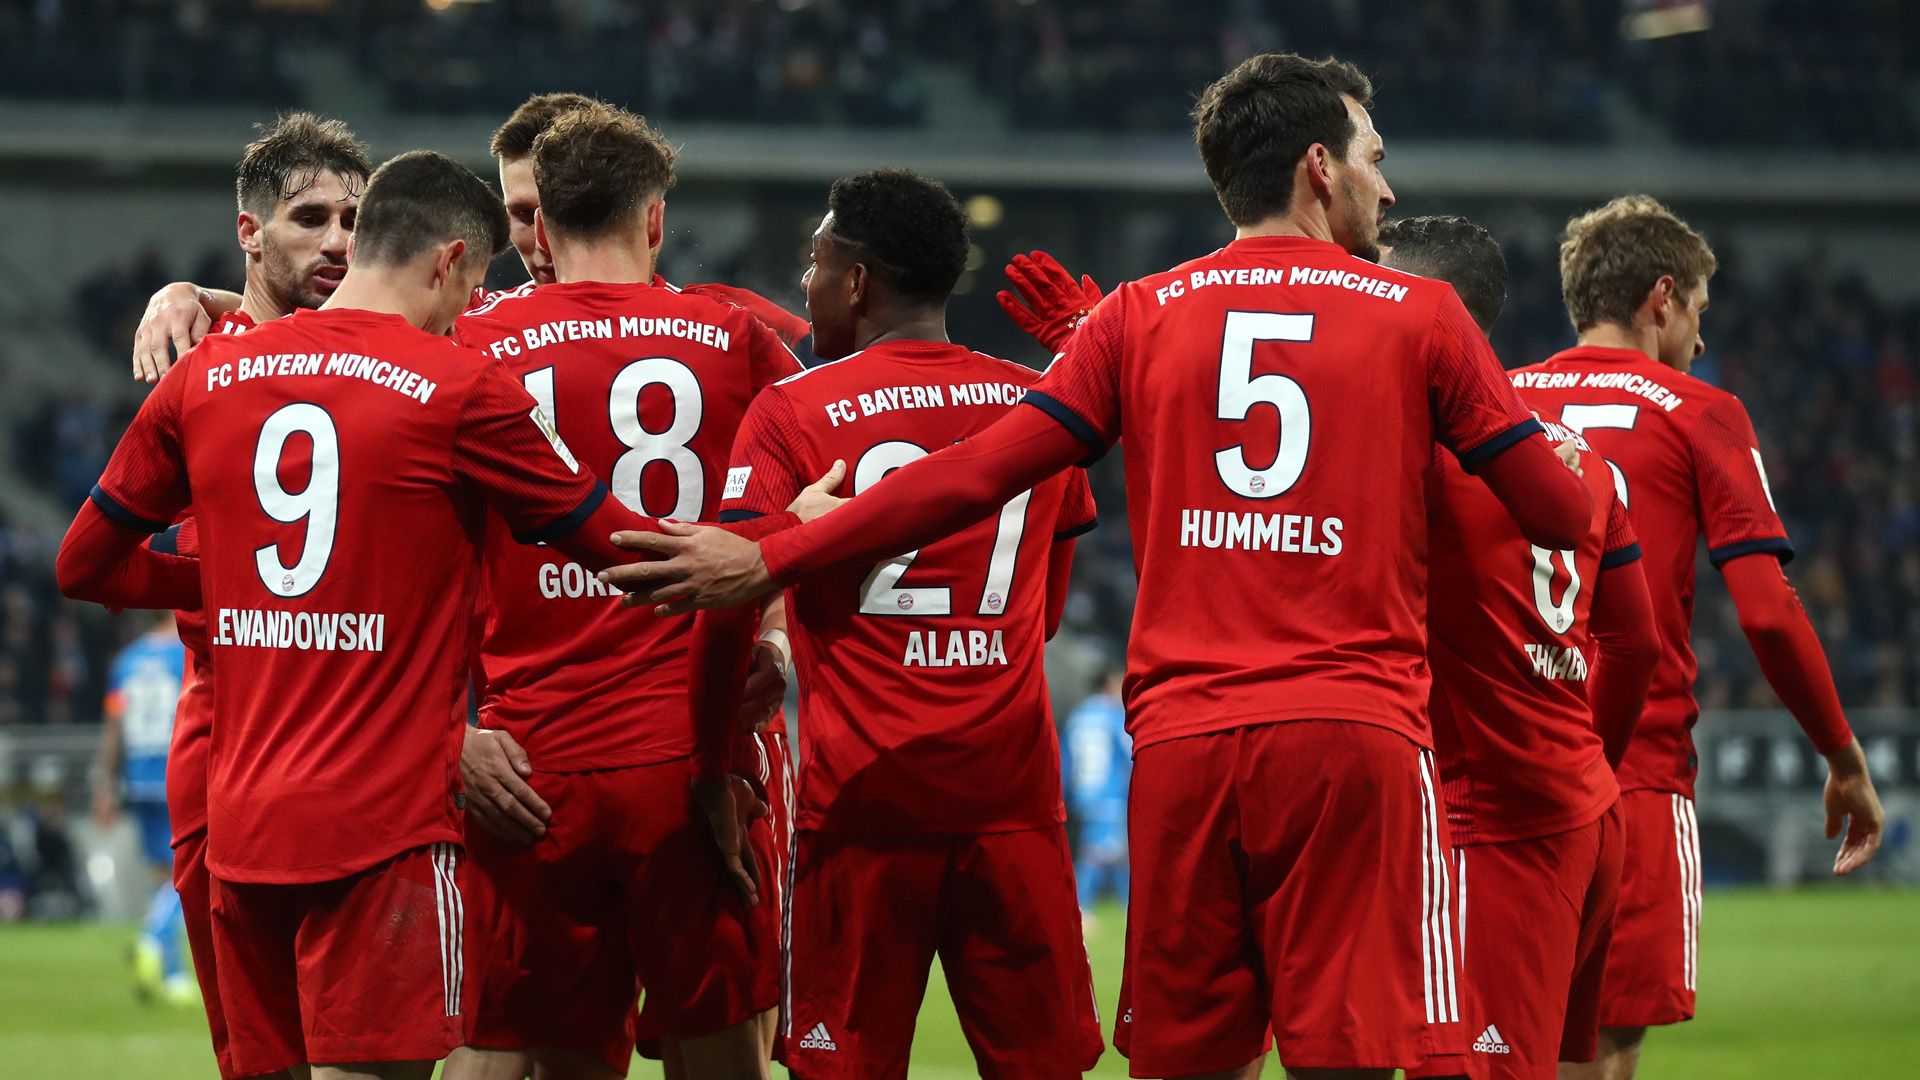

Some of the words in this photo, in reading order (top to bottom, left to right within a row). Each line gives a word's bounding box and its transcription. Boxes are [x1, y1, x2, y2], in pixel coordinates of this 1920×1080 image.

[1155, 280, 1185, 306] FC
[1190, 267, 1283, 290] BAYERN
[489, 336, 521, 359] FC
[522, 318, 612, 351] BAYERN
[207, 363, 232, 392] FC
[238, 353, 324, 382] BAYERN
[325, 352, 437, 404] MÜNCHEN
[1508, 371, 1581, 389] AYERN
[824, 399, 857, 427] FC
[857, 385, 944, 416] BAYERN
[1215, 311, 1314, 498] 5
[253, 403, 340, 597] 9
[1180, 509, 1344, 556] HUMMELS
[213, 608, 385, 652] EWANDOWSKI
[903, 629, 1008, 667] ALABA
[800, 1038, 836, 1051] adidas
